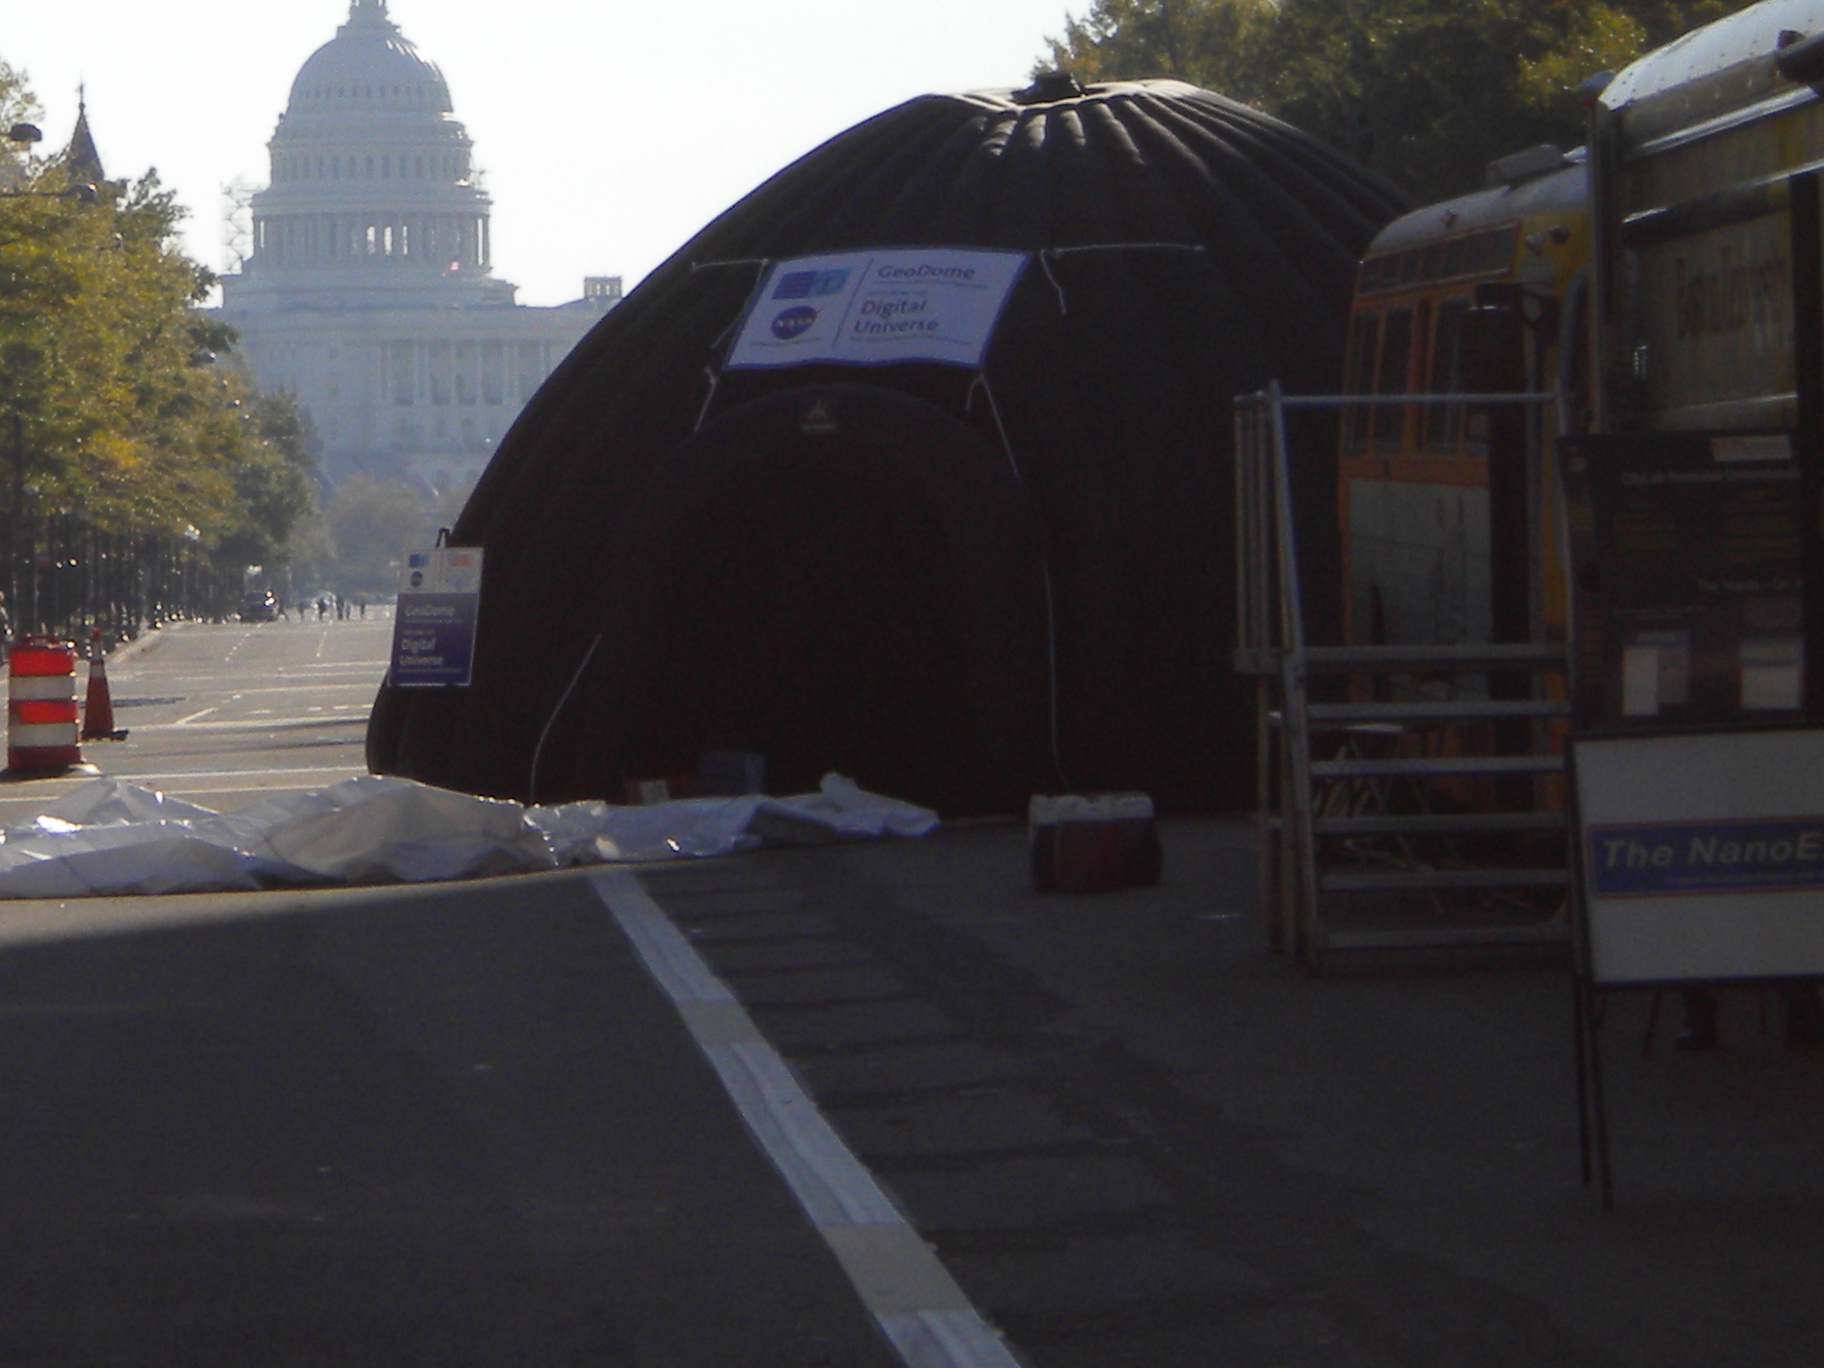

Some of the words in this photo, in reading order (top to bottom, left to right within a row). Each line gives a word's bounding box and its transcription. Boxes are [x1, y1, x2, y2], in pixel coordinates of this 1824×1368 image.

[877, 263, 976, 281] GeoDome
[861, 299, 927, 318] Digital
[853, 318, 939, 333] Universe
[1603, 838, 1673, 870] The
[1688, 831, 1824, 866] NanoE
